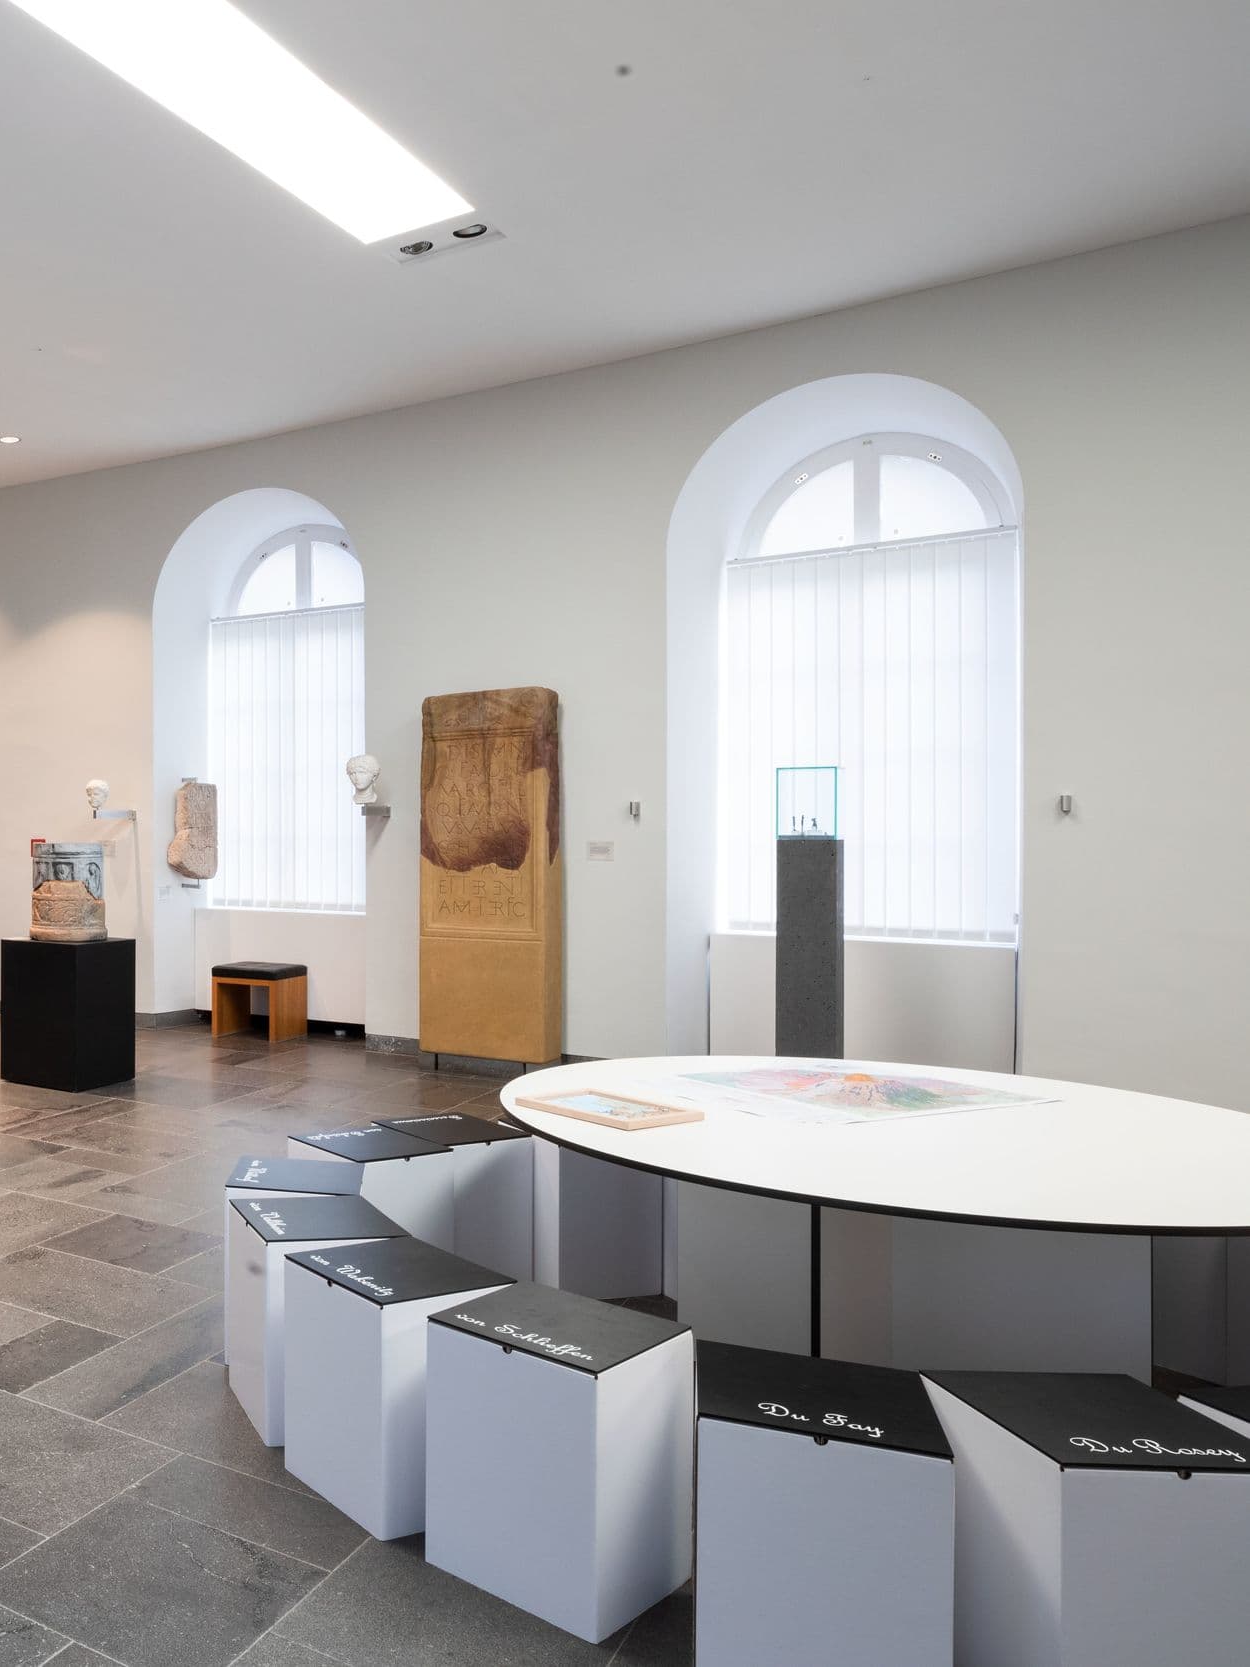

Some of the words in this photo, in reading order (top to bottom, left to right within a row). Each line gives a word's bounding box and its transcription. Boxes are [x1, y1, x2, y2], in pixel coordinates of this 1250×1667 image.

[310, 1255, 330, 1266] von
[454, 1313, 486, 1327] von
[494, 1323, 594, 1361] Schlieffen
[757, 1402, 810, 1421] Du
[822, 1413, 884, 1438] Fay
[1069, 1437, 1133, 1453] Du
[1132, 1438, 1247, 1463] Rosey
